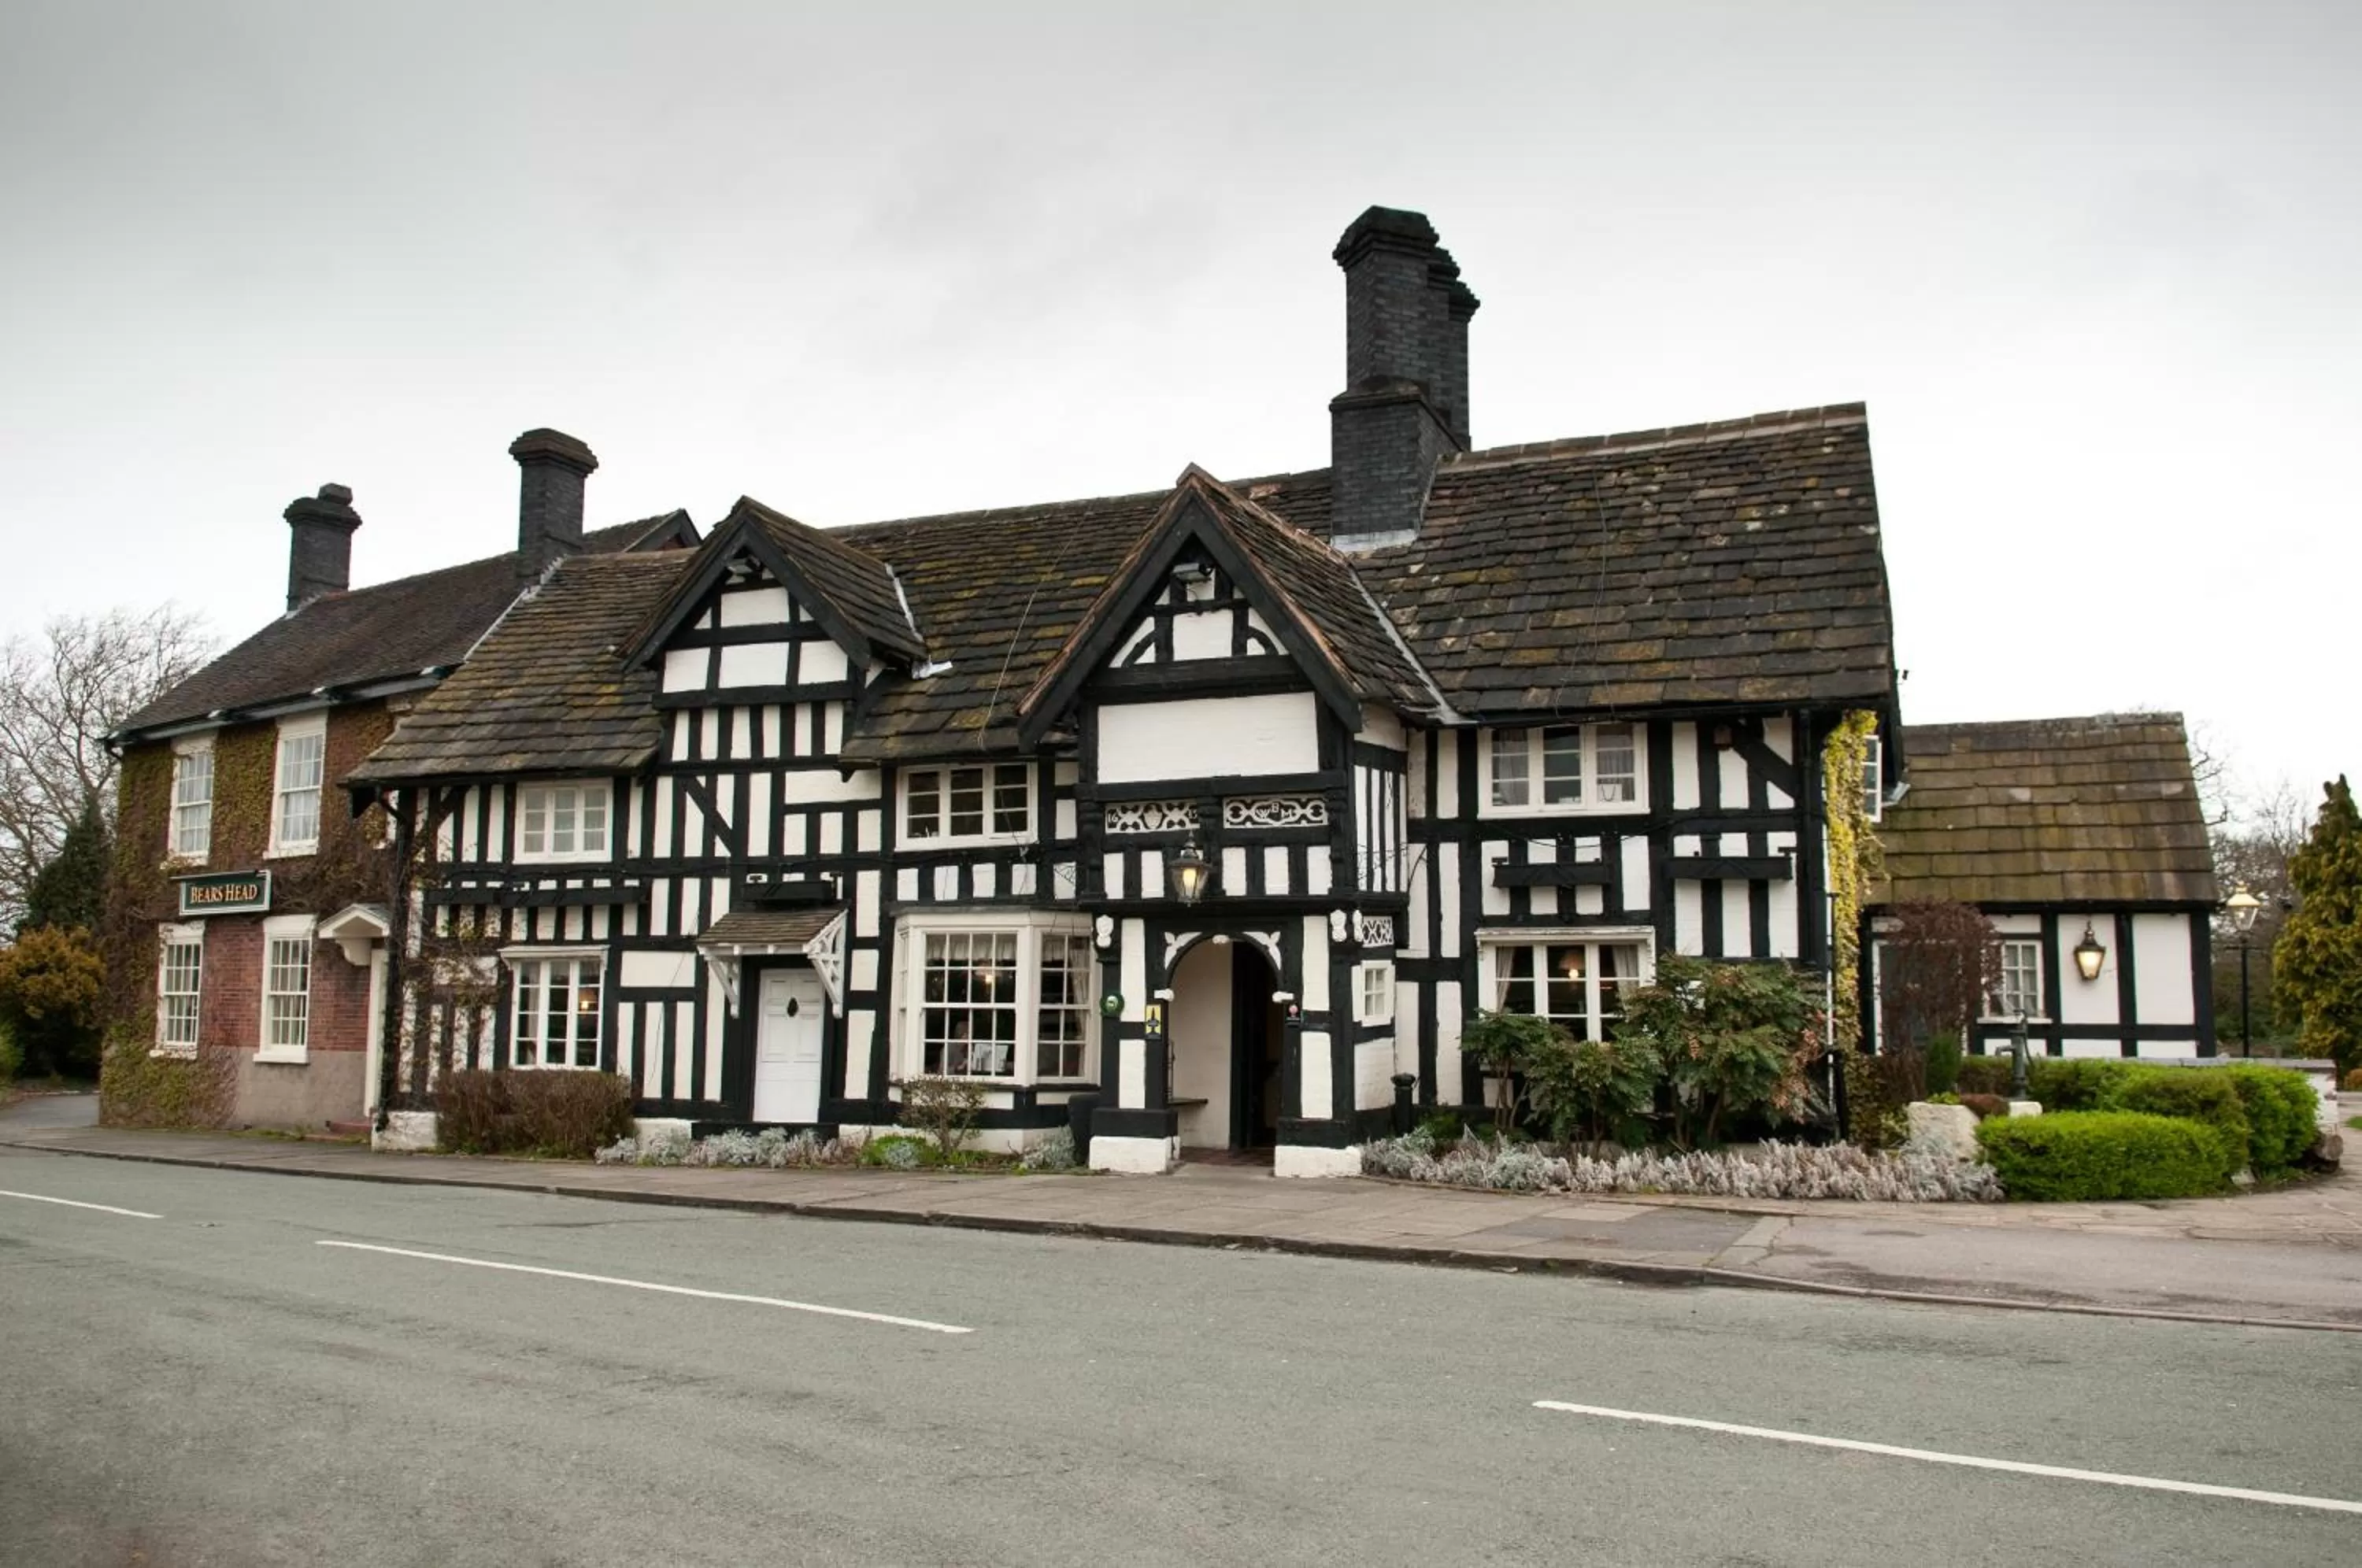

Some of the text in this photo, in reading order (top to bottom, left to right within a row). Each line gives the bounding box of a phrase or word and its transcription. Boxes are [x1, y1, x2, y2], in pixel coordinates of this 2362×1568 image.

[1108, 812, 1118, 823] 16
[190, 884, 257, 904] BEARS HEAD
